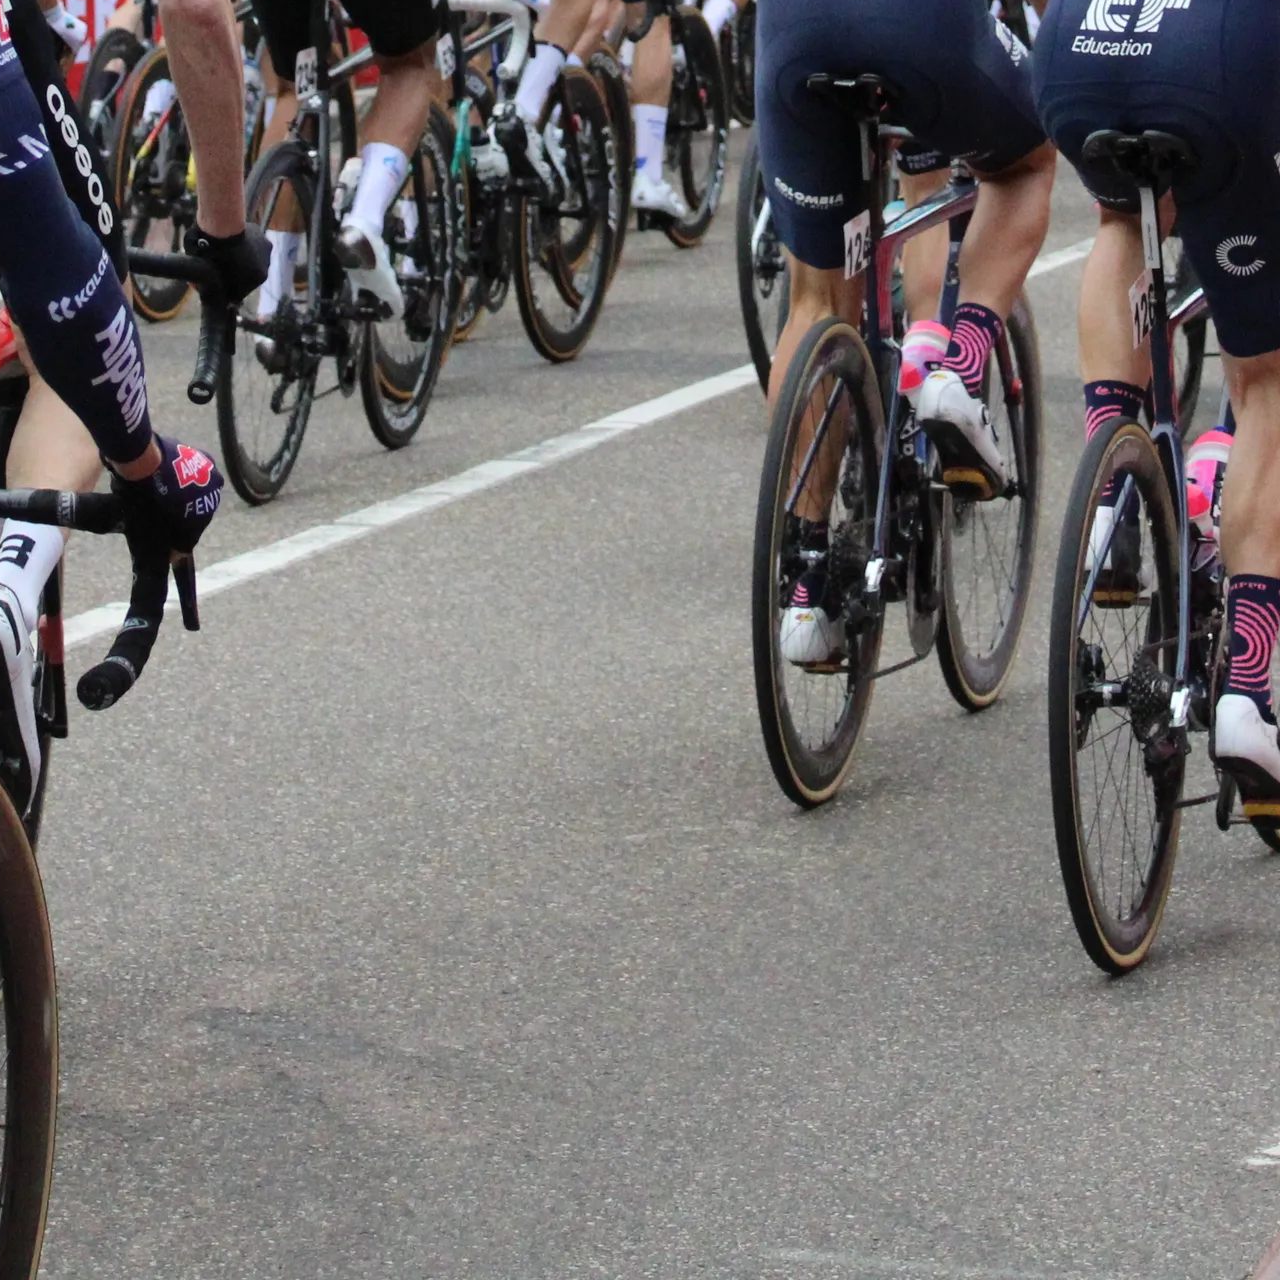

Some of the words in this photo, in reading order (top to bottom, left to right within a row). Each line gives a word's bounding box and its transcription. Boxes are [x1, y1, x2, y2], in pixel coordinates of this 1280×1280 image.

[1071, 35, 1153, 57] Education
[45, 83, 114, 236] assos
[774, 176, 845, 207] COLOMBIA
